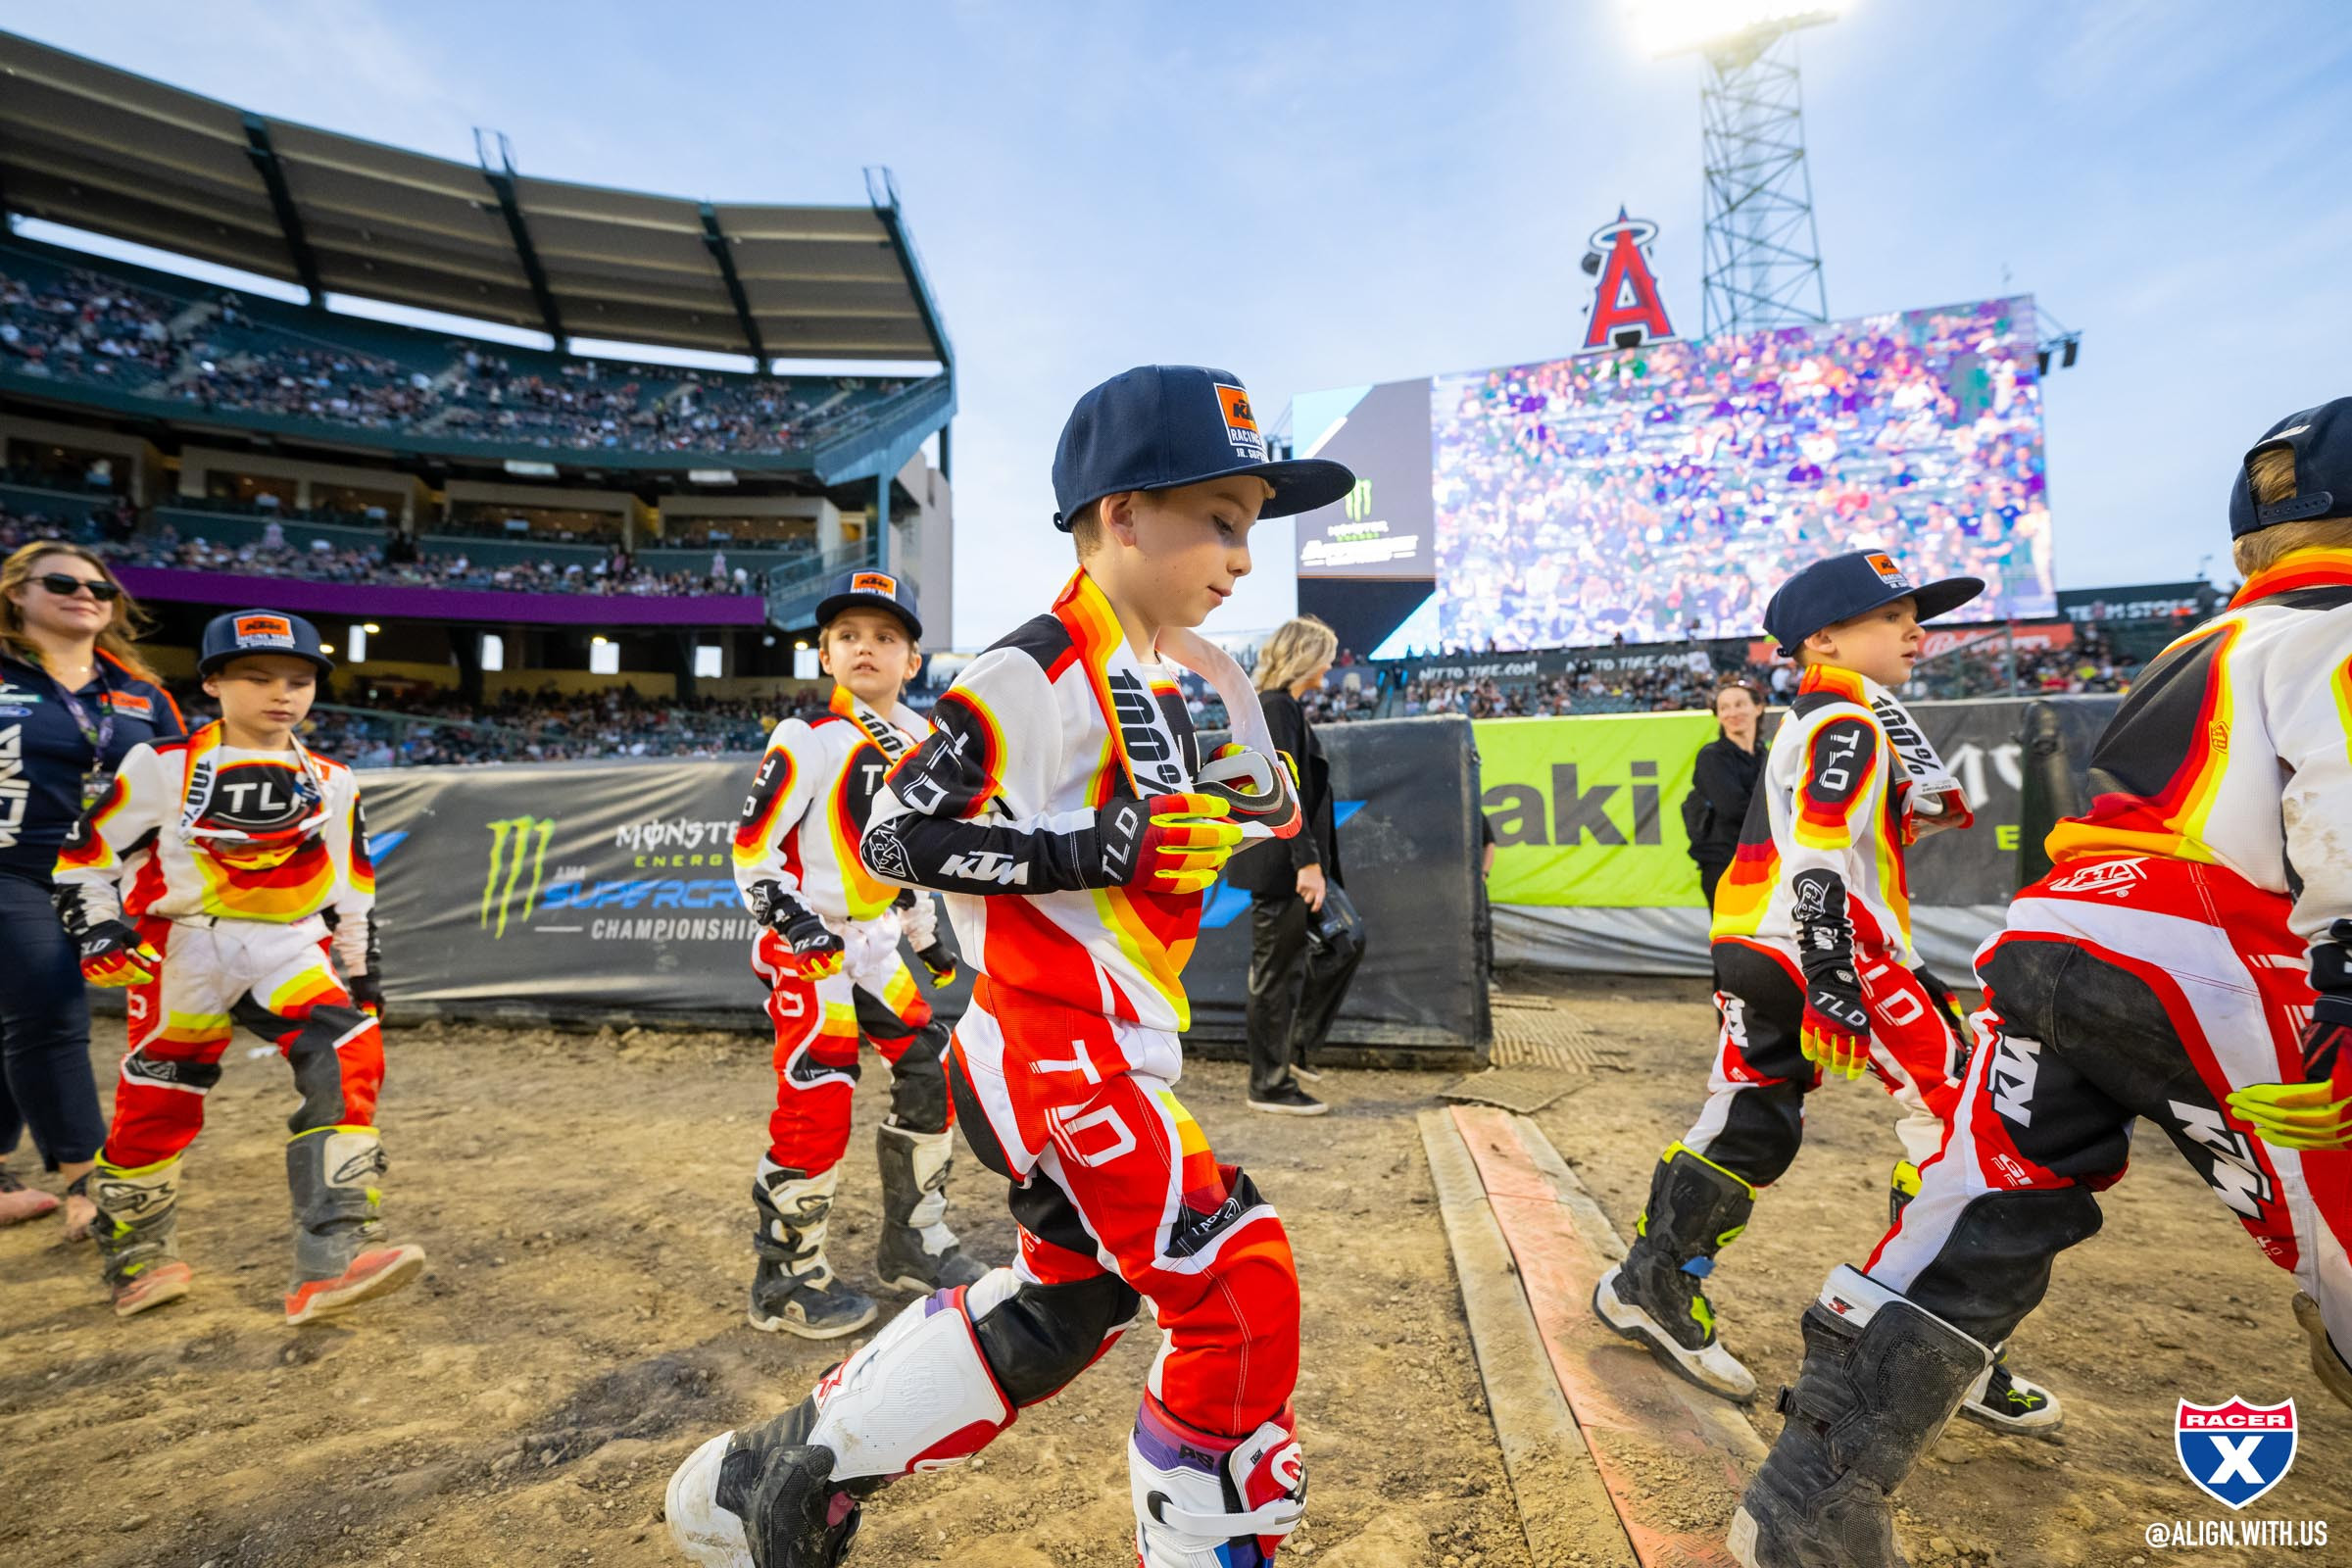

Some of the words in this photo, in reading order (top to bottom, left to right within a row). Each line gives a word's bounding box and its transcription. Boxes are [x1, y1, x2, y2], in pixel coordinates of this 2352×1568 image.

[1582, 204, 1676, 349] A
[858, 710, 907, 761] 100
[1872, 695, 1940, 775] 100%
[222, 782, 294, 812] TL
[615, 817, 741, 851] MONSTE
[1102, 807, 1139, 882] TLD
[634, 853, 734, 867] ENERG
[938, 851, 1030, 885] KTM
[540, 879, 747, 909] SUPERCR
[1815, 991, 1867, 1027] TLD
[1987, 1031, 2041, 1128] KTM
